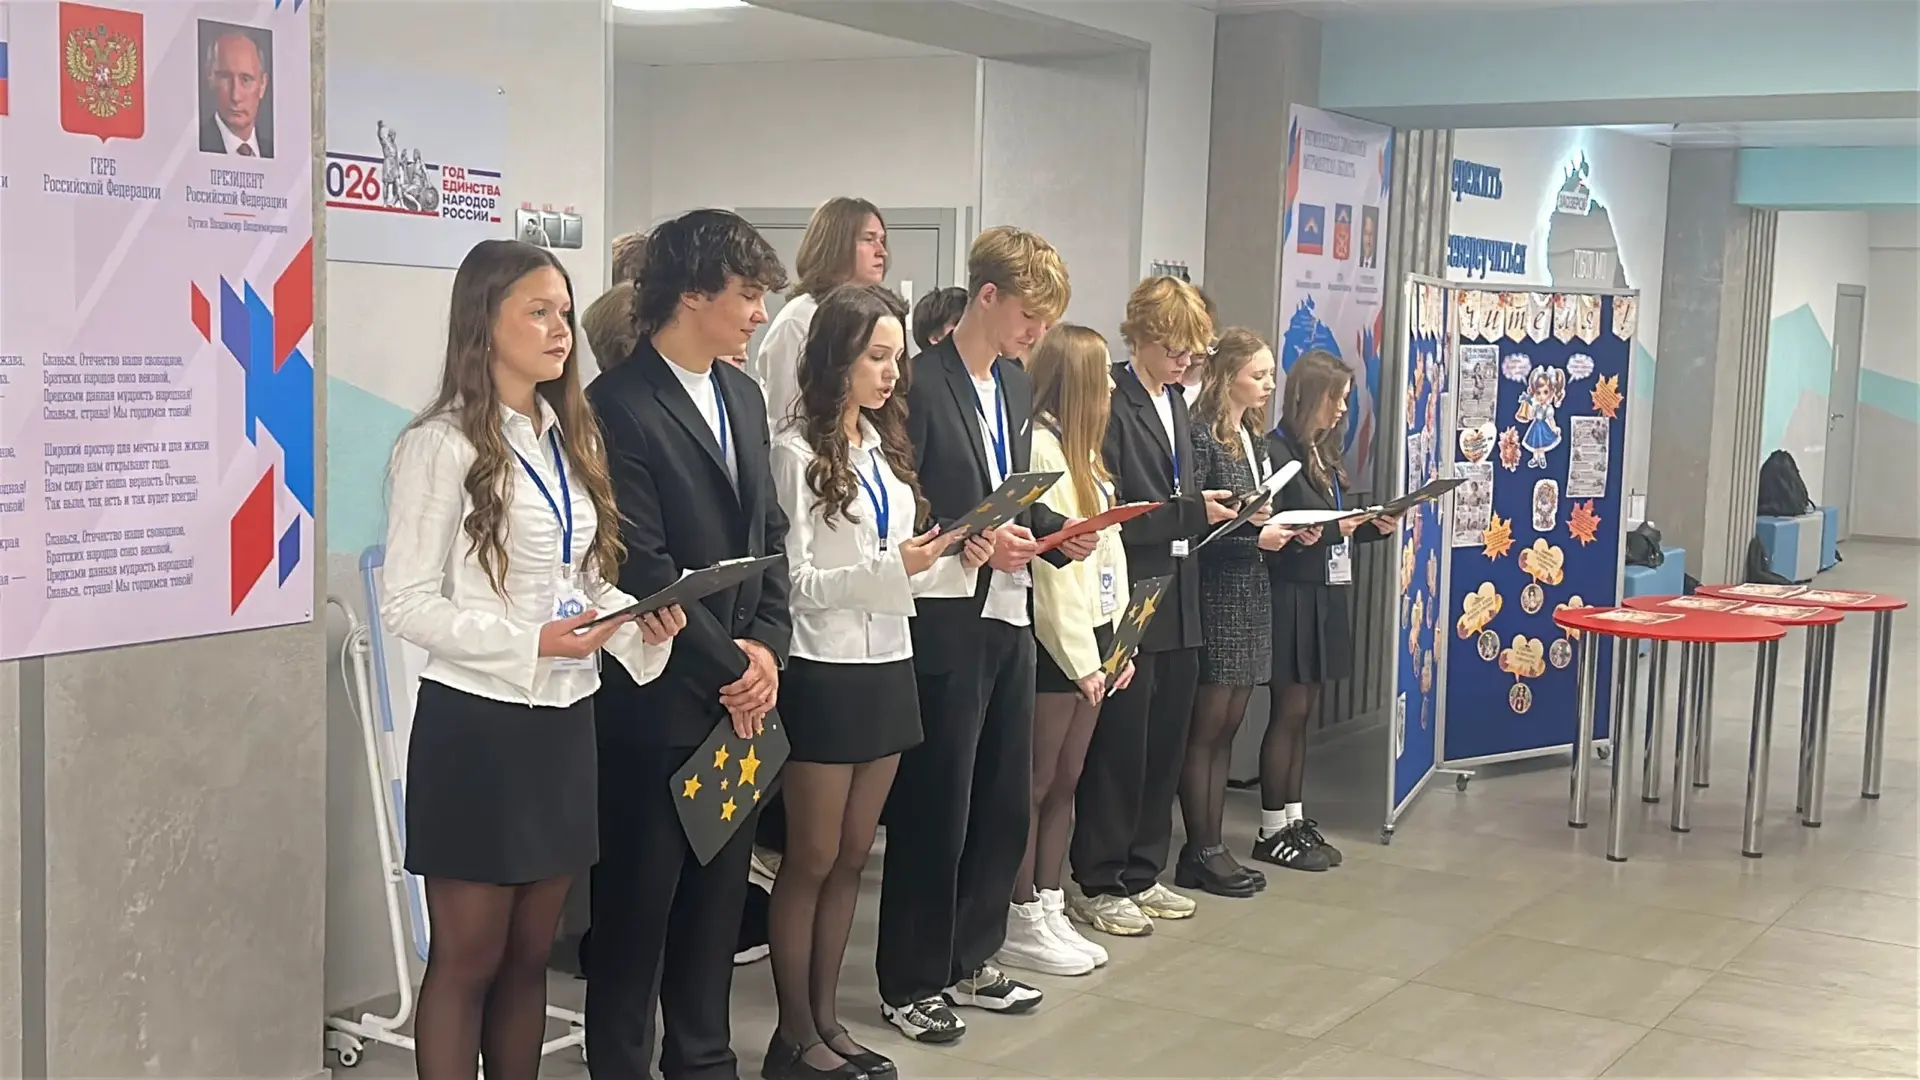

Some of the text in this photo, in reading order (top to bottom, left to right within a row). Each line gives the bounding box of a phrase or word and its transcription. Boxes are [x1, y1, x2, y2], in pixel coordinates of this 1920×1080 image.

[90, 157, 116, 176] ГЕРБ
[442, 165, 465, 180] ГОД
[43, 173, 161, 201] Российской Федерации
[210, 168, 264, 189] ПРЕЗИДЕНТ
[326, 162, 381, 201] 026
[442, 180, 501, 196] ЕДИНСТВА
[186, 185, 288, 210] Российской Федерации
[442, 194, 496, 209] НАРОДОВ
[442, 208, 489, 221] РОССИИ
[43, 352, 77, 366] Славься,
[80, 352, 119, 366] Отечество
[122, 355, 142, 366] наше
[43, 370, 81, 386] Братских
[84, 373, 115, 385] народов
[117, 373, 136, 384] союз
[43, 388, 84, 404] Предками
[86, 391, 115, 402] данная
[117, 391, 153, 404] мудрость
[81, 405, 111, 421] страна!
[113, 405, 128, 418] Мы
[130, 407, 166, 420] гордимся
[168, 404, 192, 417] тобой!
[44, 441, 210, 459] Широкий простор для мечты и для жизни
[44, 460, 84, 477] Грядущие
[87, 462, 103, 472] нам
[105, 460, 150, 473] открывают
[44, 478, 62, 492] Нам
[64, 481, 83, 495] силу
[85, 476, 104, 491] даёт
[106, 478, 127, 489] наша
[129, 476, 164, 489] верность
[45, 496, 61, 510] Так
[88, 497, 103, 508] так
[104, 496, 123, 506] есть
[124, 495, 130, 505] и
[131, 494, 146, 505] так
[147, 492, 170, 505] будет
[171, 488, 198, 503] всегда!
[82, 529, 122, 543] Отечество
[124, 529, 145, 540] наше
[46, 549, 84, 565] Братских
[86, 547, 118, 562] народов
[46, 567, 86, 584] Предками
[88, 565, 117, 578] данная
[119, 561, 156, 576] мудрость
[83, 579, 113, 597] страна!
[115, 578, 130, 592] Мы
[132, 578, 168, 592] гордимся
[170, 573, 194, 588] тобой!
